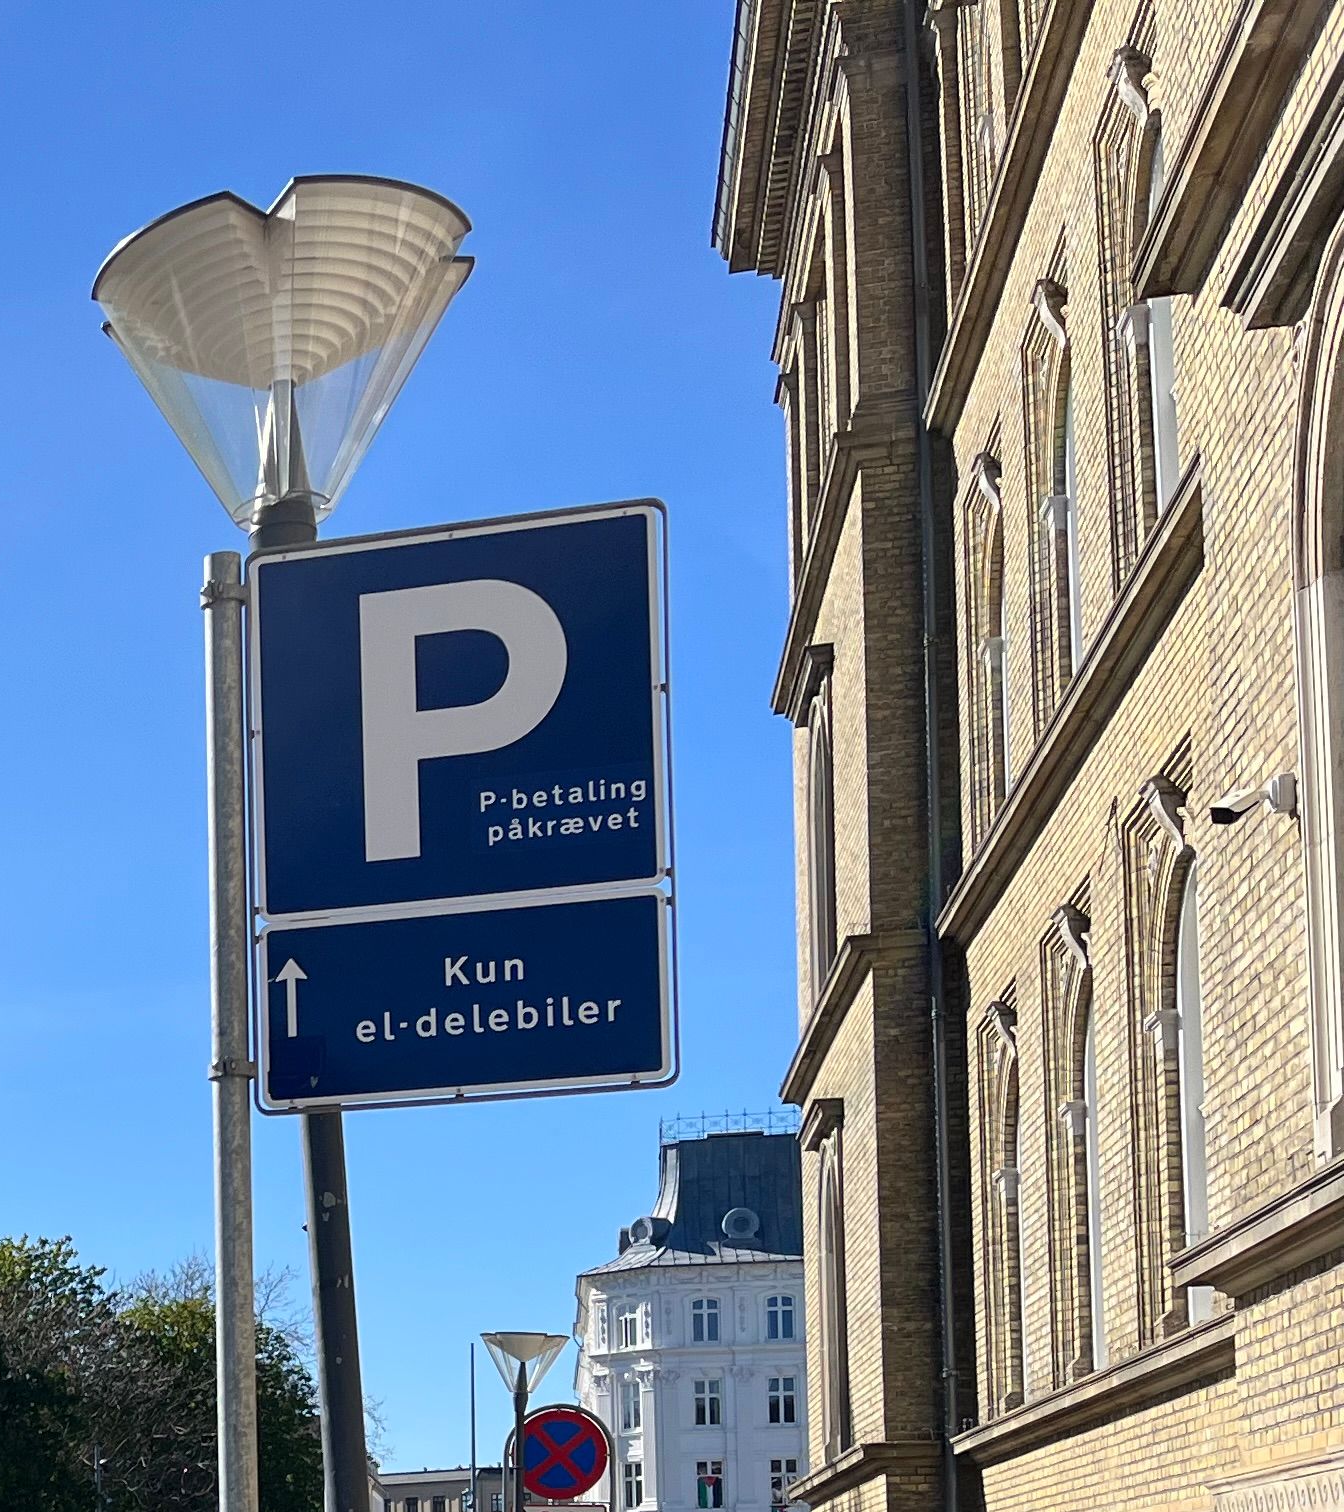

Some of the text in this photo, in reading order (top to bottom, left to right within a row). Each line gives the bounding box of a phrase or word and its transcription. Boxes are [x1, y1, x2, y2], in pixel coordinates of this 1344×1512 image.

[359, 579, 568, 862] P
[480, 779, 647, 812] P-betaling
[488, 807, 640, 846] påkrævet
[445, 956, 524, 987] Kun
[356, 997, 622, 1043] el-delebiler
